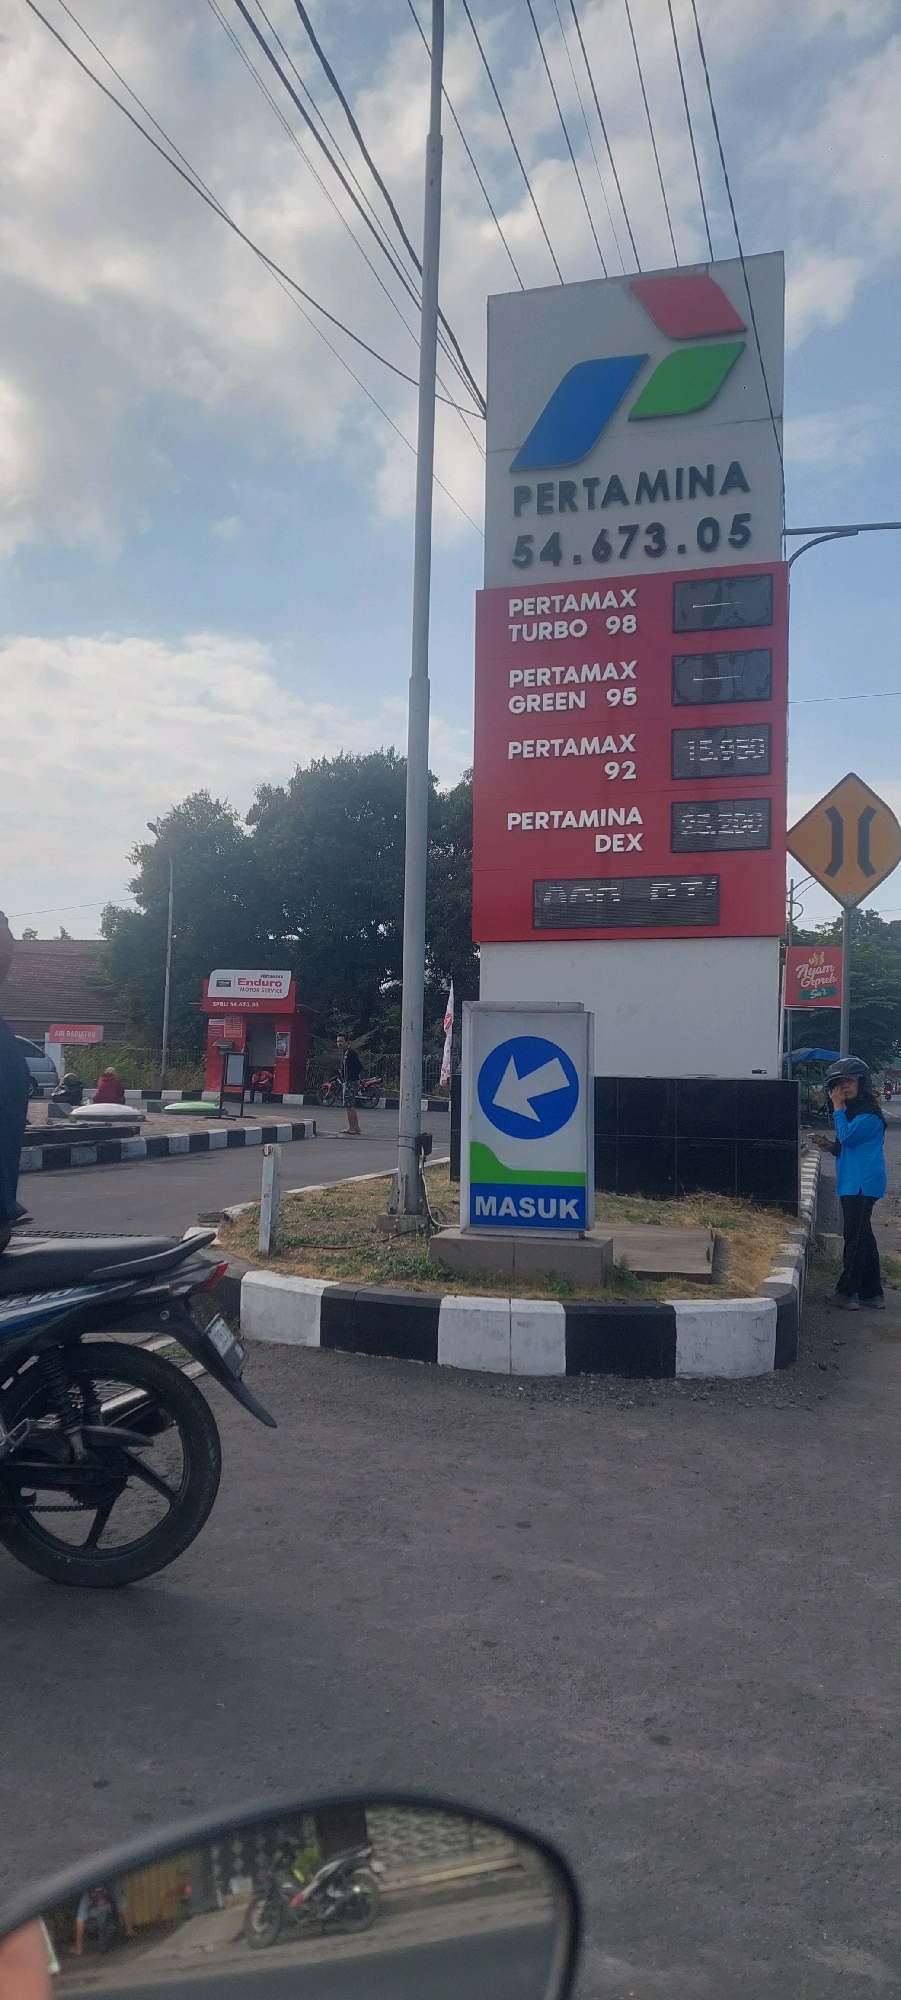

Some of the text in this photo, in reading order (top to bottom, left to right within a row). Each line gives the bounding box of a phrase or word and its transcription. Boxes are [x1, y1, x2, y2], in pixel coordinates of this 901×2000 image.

[513, 461, 751, 517] PERTAMINA
[511, 513, 752, 569] 54.673.05
[508, 588, 637, 617] PERTAMAX
[508, 614, 637, 642] TURBO 98
[508, 660, 638, 688] PERTAMAX
[508, 686, 638, 715] GREEN 95
[508, 733, 636, 760] PERTAMAX
[604, 761, 637, 780] 92
[507, 806, 644, 831] PERTAMINA
[595, 833, 644, 853] DEX
[237, 977, 283, 988] Enduro
[795, 963, 836, 979] Ayam
[800, 973, 838, 989] Geprek
[66, 1030, 96, 1038] RADIATOR
[475, 1196, 580, 1220] MASUK
